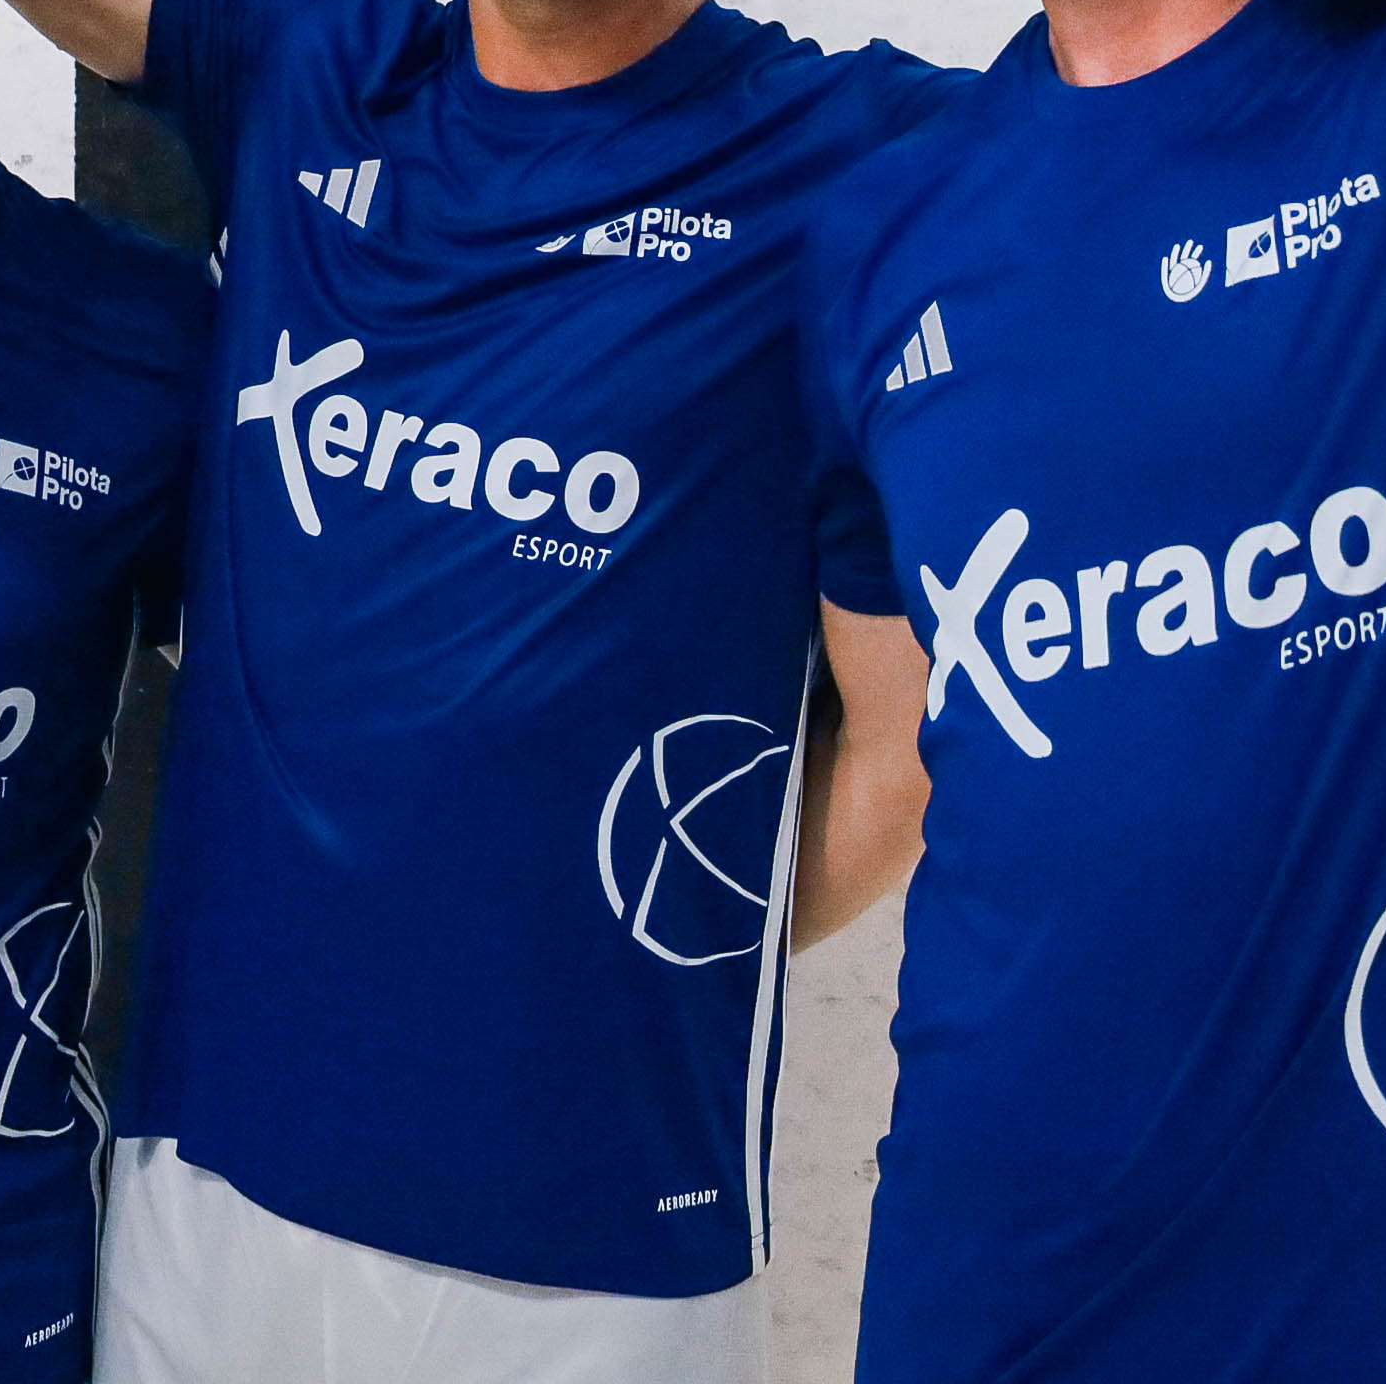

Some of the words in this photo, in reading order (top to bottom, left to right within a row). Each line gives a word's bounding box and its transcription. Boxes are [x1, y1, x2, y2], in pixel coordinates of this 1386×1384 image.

[1279, 173, 1381, 237] Pilota
[639, 207, 732, 241] Pilota
[636, 233, 691, 262] Pro
[1284, 223, 1342, 270] Pro
[237, 329, 640, 537] Xeraco
[42, 450, 111, 495] Pilota
[42, 476, 84, 511] Pro
[512, 534, 612, 571] ESPORT
[657, 1189, 718, 1212] AEROREADY
